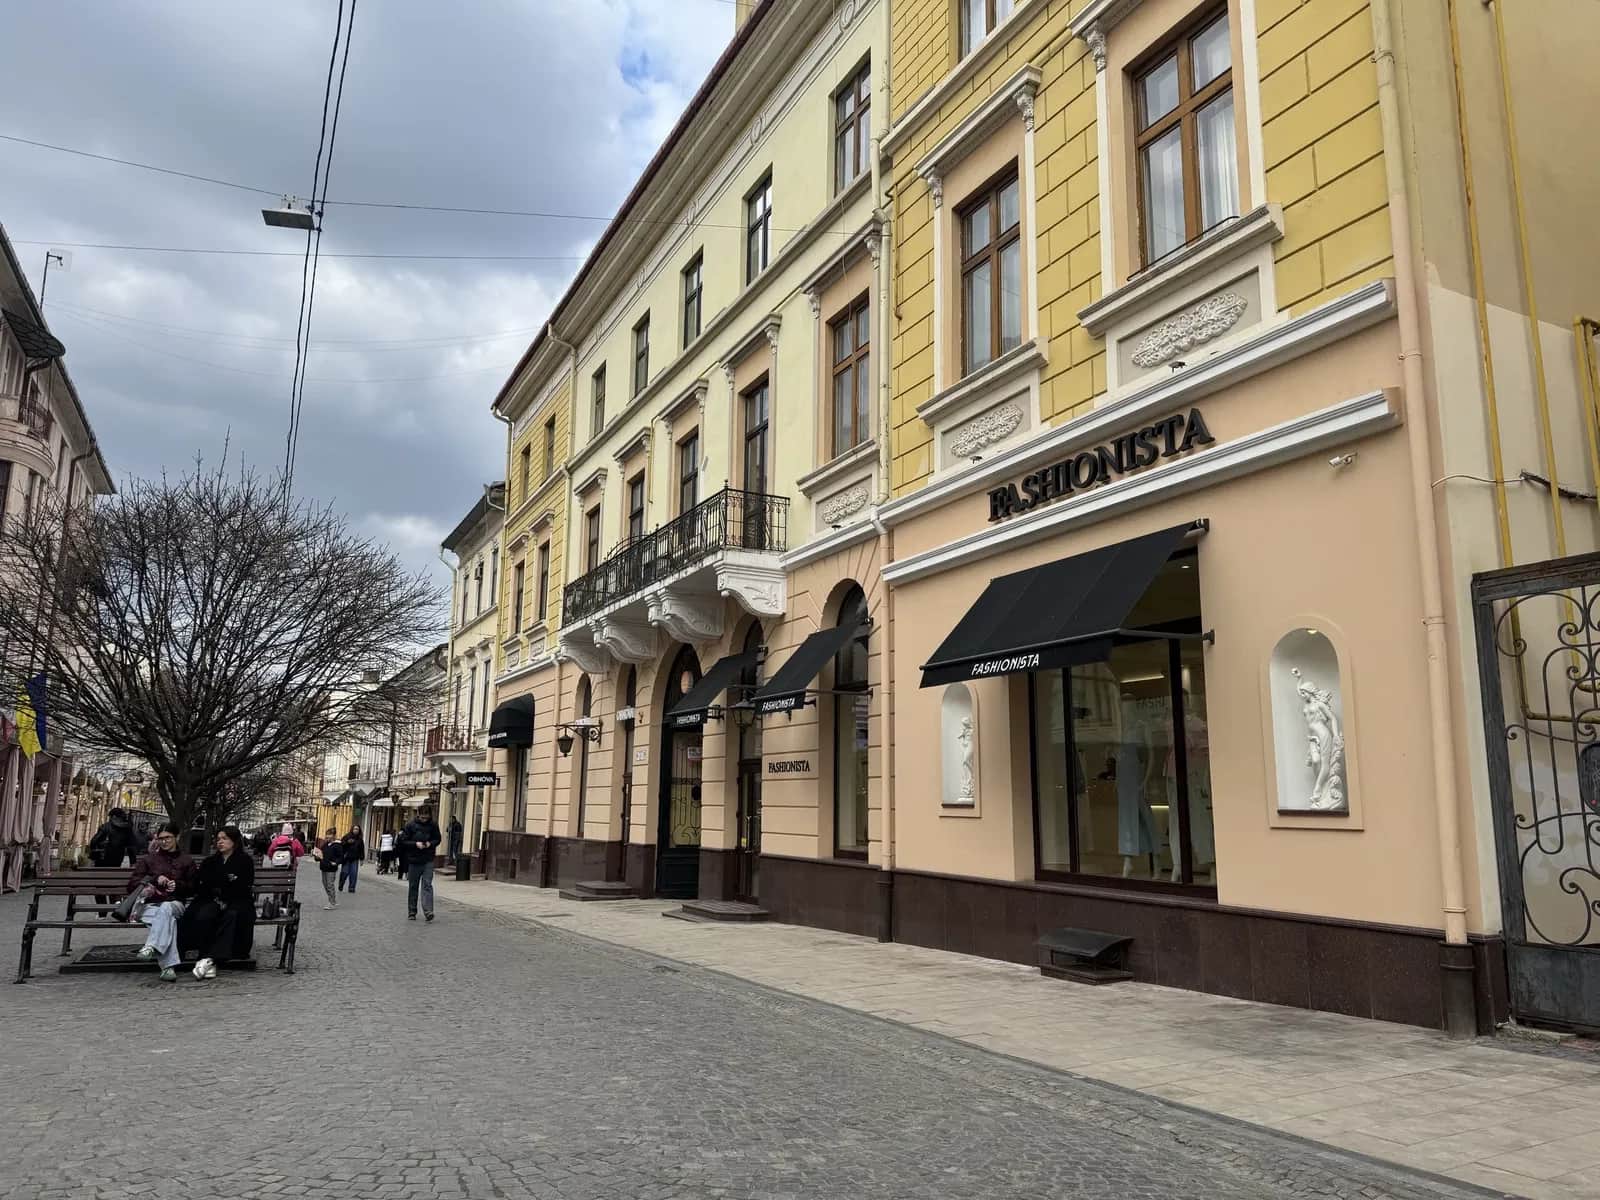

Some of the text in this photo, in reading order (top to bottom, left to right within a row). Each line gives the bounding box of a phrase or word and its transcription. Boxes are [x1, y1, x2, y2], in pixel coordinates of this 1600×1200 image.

[988, 408, 1215, 521] FASHIONISTA
[971, 653, 1039, 676] FASHIONISTA
[762, 698, 795, 711] FASHIONISTA
[768, 760, 810, 773] FASHIONISTA
